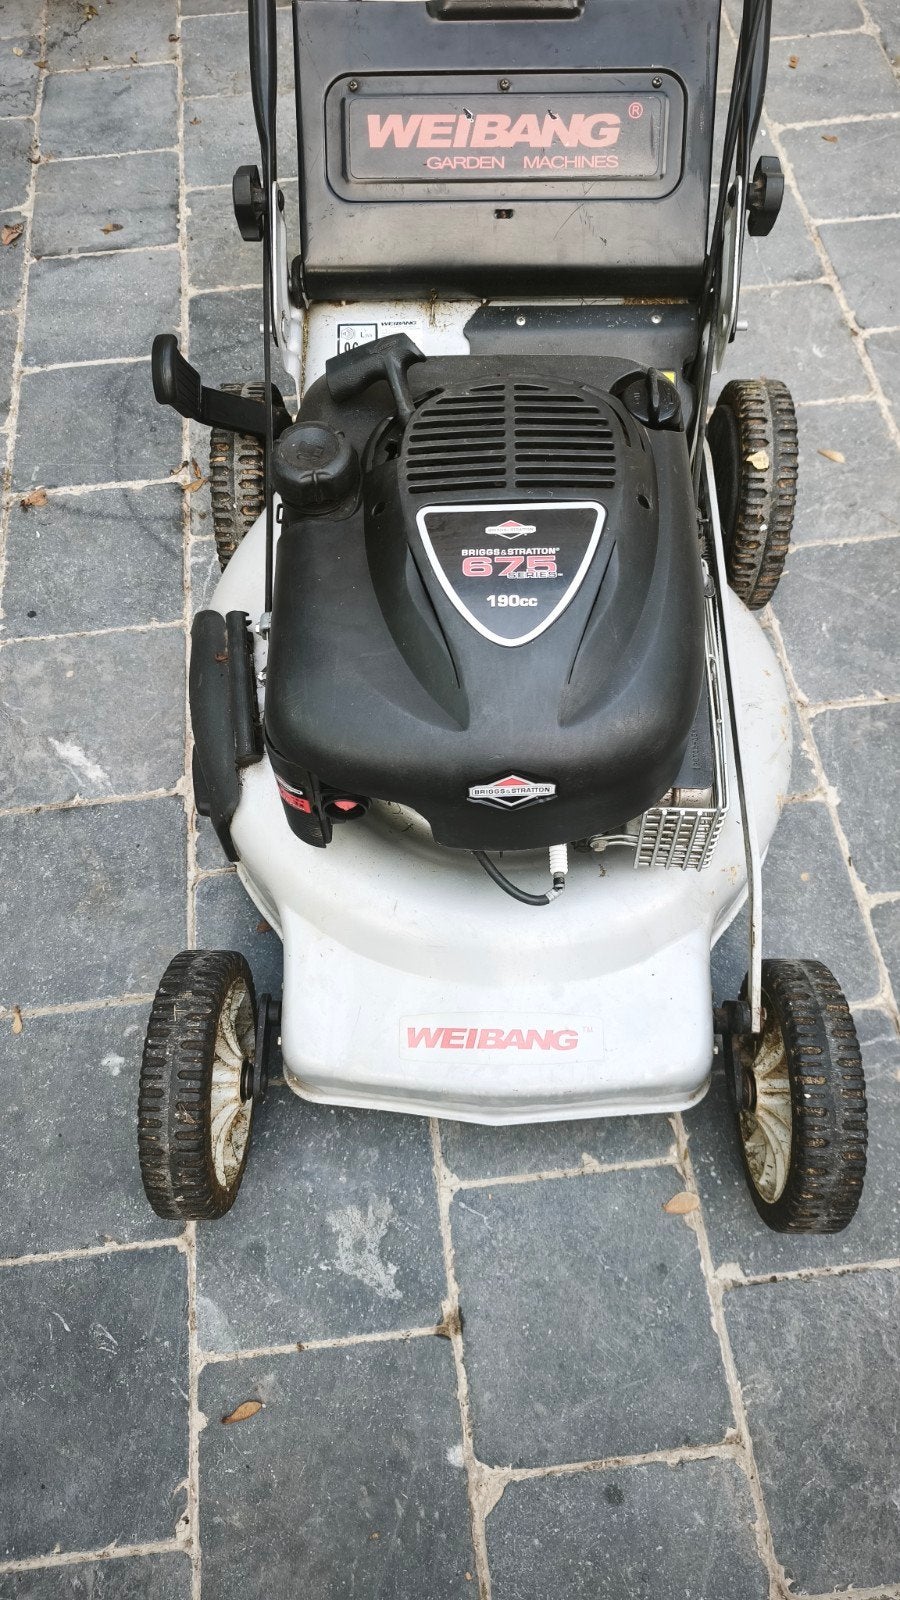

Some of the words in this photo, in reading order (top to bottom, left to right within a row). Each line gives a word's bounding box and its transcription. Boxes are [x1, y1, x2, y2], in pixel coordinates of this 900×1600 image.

[367, 113, 621, 148] WEIBANG
[426, 155, 505, 170] GARDEN
[523, 155, 619, 169] MACHINES
[462, 555, 558, 577] 675
[486, 594, 538, 608] 190cc
[407, 1027, 579, 1051] WEIBANG
